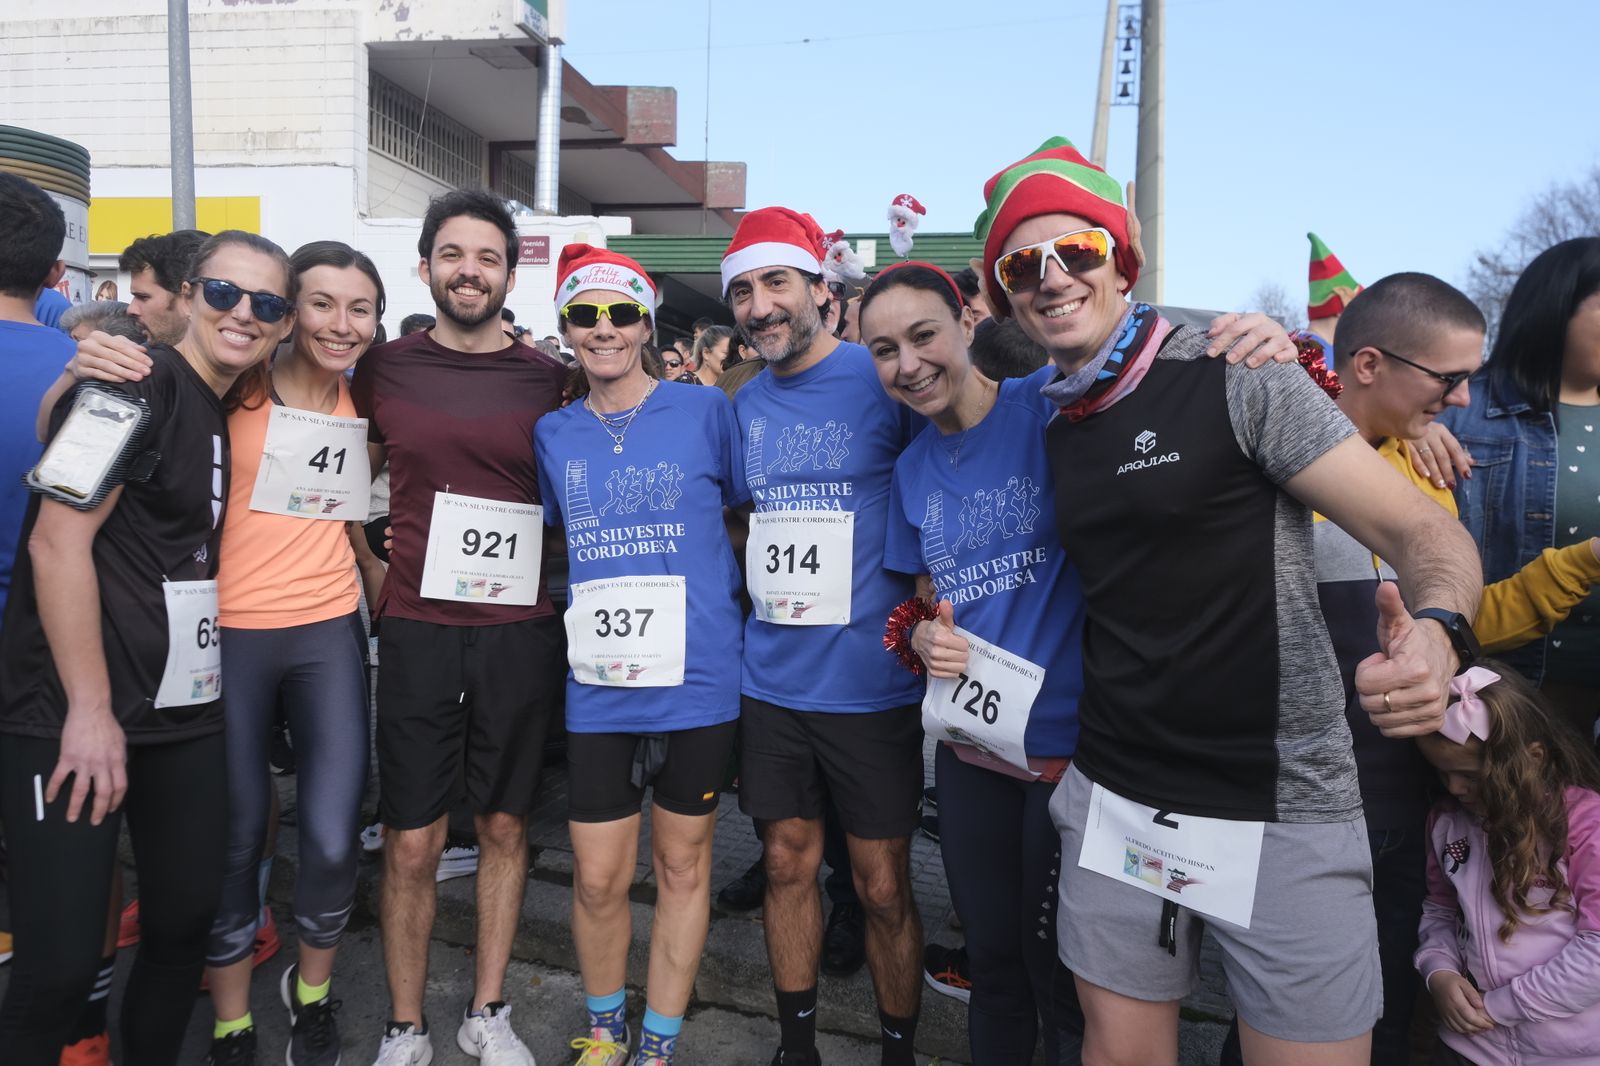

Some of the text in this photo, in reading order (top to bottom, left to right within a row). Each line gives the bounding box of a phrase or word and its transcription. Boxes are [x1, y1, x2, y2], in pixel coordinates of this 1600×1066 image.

[580, 274, 630, 288] Navidad
[590, 265, 620, 276] Feliz
[292, 414, 307, 422] SAN
[308, 416, 346, 428] SILVESTRE
[308, 446, 346, 475] 41
[1116, 452, 1180, 476] ARQUIAG
[768, 482, 852, 500] SILVESTRE
[470, 502, 507, 513] SILVESTRE
[756, 499, 844, 513] CORDOBESA
[461, 529, 517, 560] 921
[569, 523, 686, 548] SAN SILVESTRE
[577, 540, 678, 562] CORDOBESA
[766, 544, 821, 574] 314
[933, 547, 1047, 592] SAN SILVESTRE
[942, 568, 1037, 606] CORDOBESA
[594, 608, 654, 638] 337
[998, 657, 1038, 681] CORDOBESA
[951, 672, 1001, 725] 726
[1124, 836, 1151, 851] ALFREDO
[1153, 848, 1187, 864] ACEITUNO
[1188, 859, 1216, 872] HISPAN
